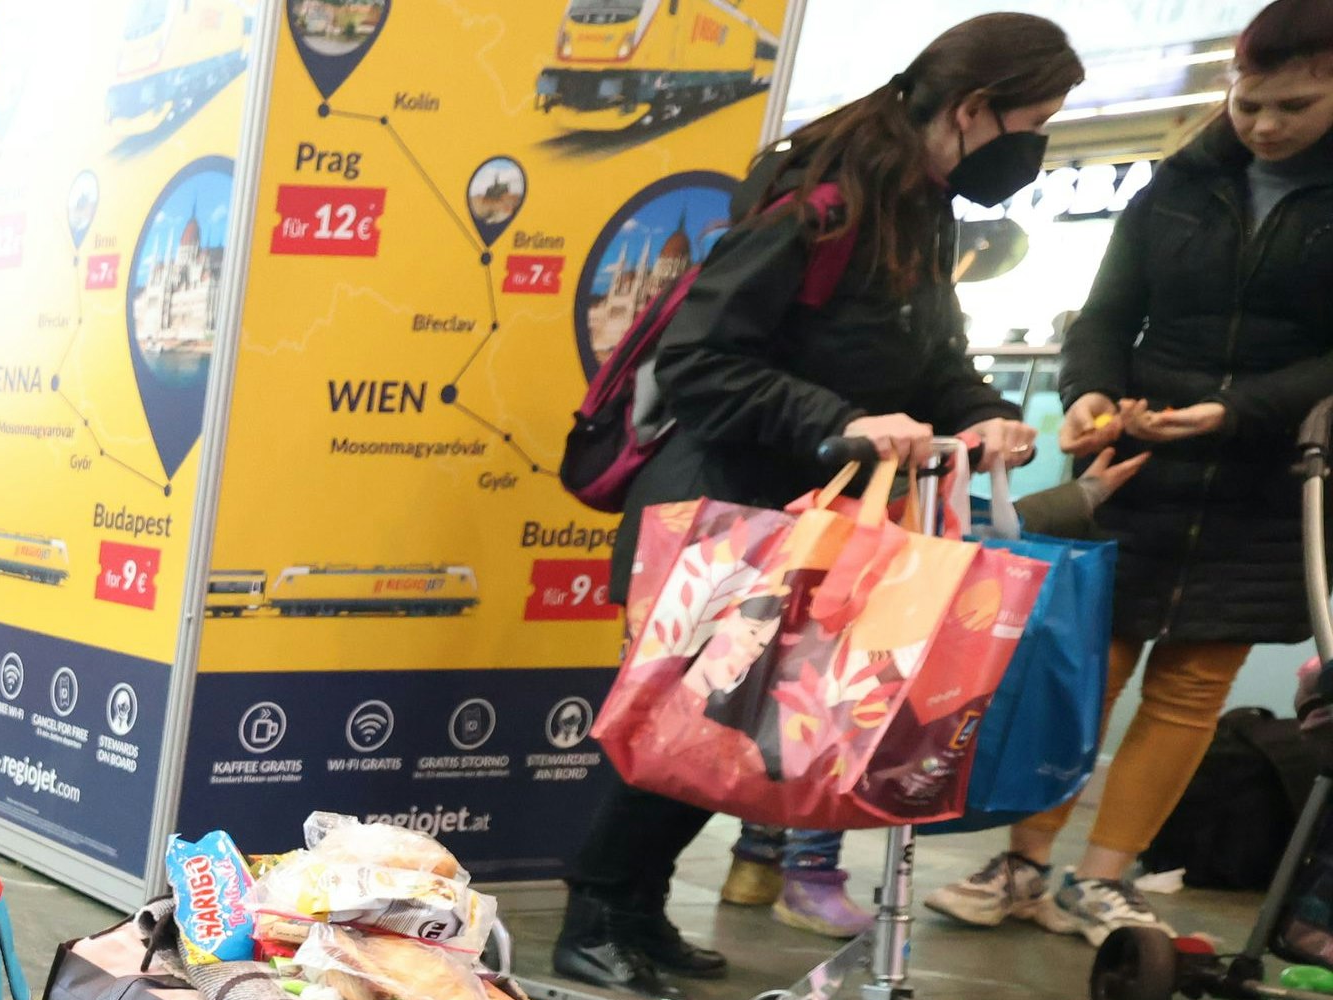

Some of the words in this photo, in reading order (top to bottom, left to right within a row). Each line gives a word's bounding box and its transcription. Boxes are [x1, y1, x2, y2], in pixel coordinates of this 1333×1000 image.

[295, 143, 362, 180] Prag
[282, 218, 309, 238] für
[328, 380, 429, 414] WIEN
[93, 503, 173, 539] Budapest
[521, 520, 618, 552] Budape
[105, 569, 122, 588] for
[31, 713, 57, 732] CANCEL
[57, 720, 73, 737] FOR
[72, 724, 90, 743] FREE
[98, 734, 140, 760] STEWARDS
[96, 748, 111, 765] ON
[110, 752, 138, 773] BOARD
[212, 760, 259, 774] KAFFEE
[259, 759, 303, 773] GRATIS
[359, 758, 403, 772] GRATIS
[418, 756, 461, 770] GRATIS
[460, 755, 511, 769] STORNO
[552, 767, 589, 781] BORD
[183, 855, 225, 940] HARIBO
